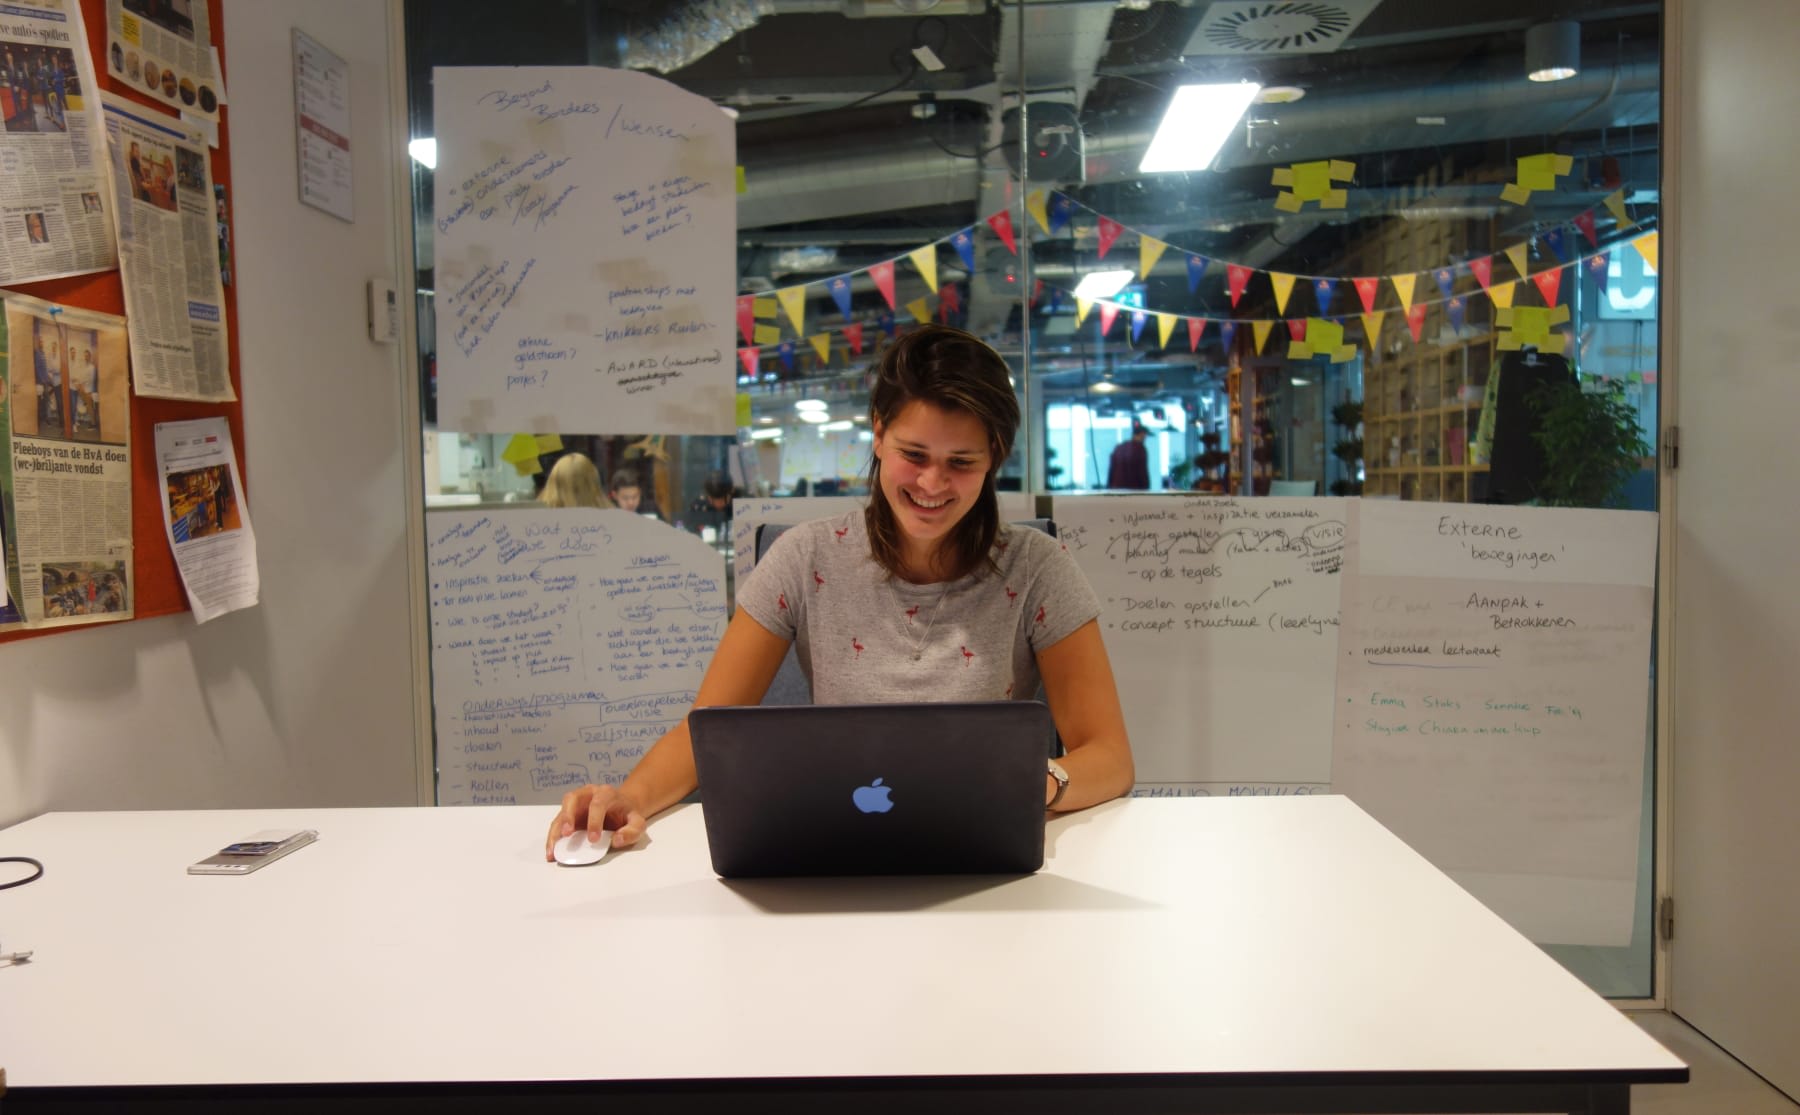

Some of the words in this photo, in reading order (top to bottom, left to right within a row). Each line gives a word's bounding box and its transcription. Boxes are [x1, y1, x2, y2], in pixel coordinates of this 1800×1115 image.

[13, 442, 51, 458] Pleeboys
[54, 448, 69, 458] van
[71, 447, 81, 459] de
[84, 448, 102, 461] HvA
[105, 449, 127, 463] doen
[75, 463, 104, 475] vondst
[1140, 569, 1156, 583] op
[1160, 566, 1175, 578] de
[1182, 567, 1222, 584] tegels
[1120, 597, 1175, 611] Doelen
[1184, 594, 1250, 614] opstellen
